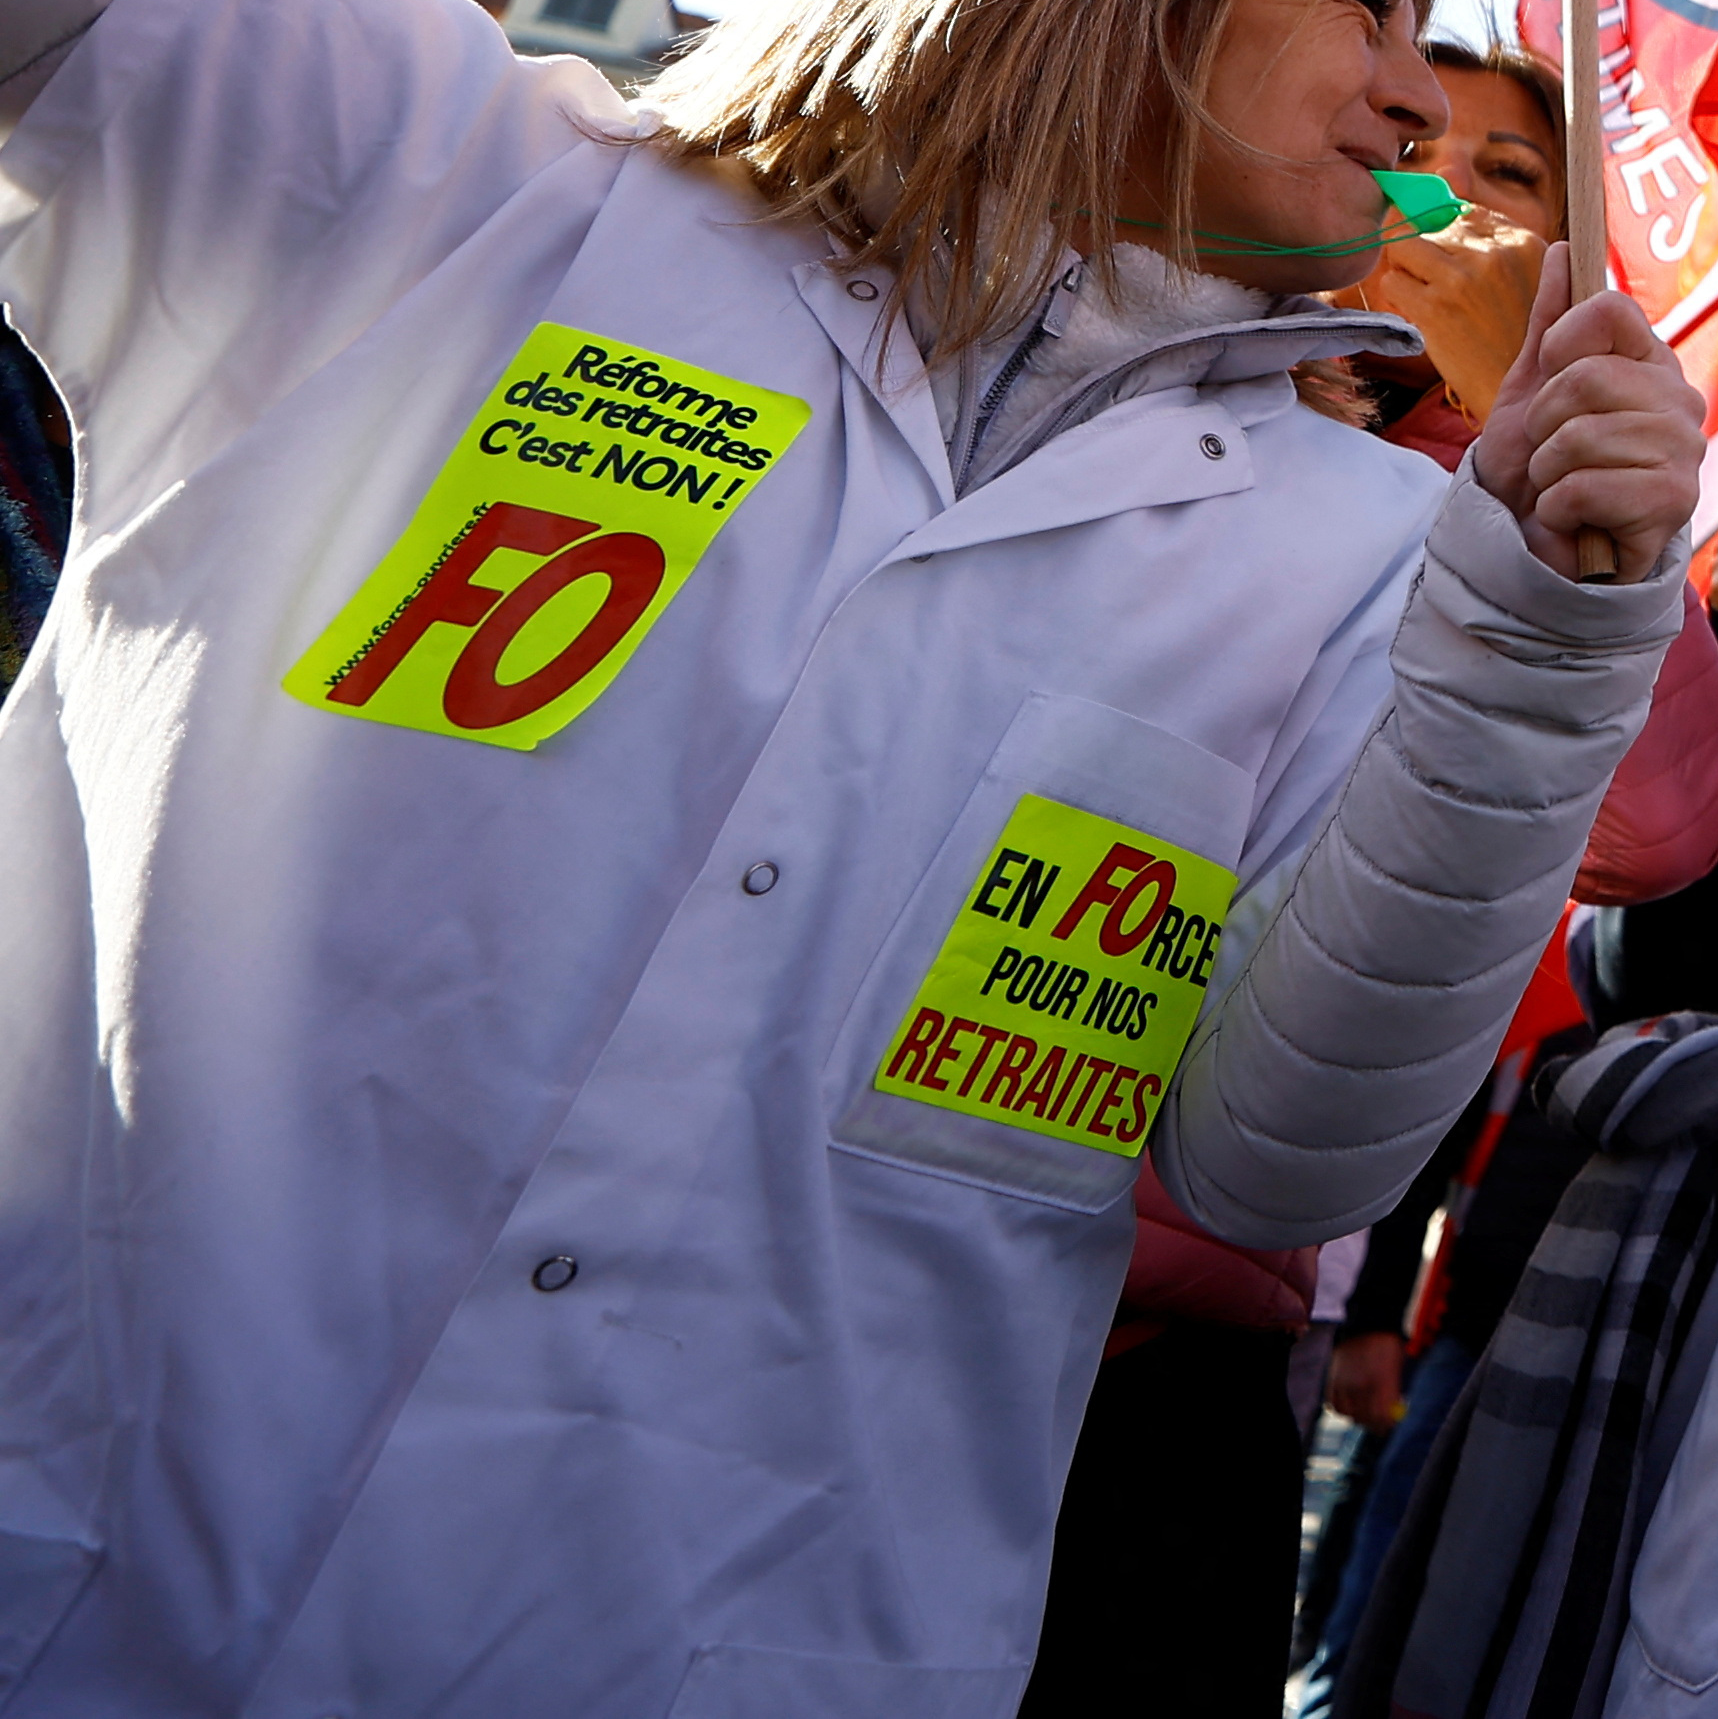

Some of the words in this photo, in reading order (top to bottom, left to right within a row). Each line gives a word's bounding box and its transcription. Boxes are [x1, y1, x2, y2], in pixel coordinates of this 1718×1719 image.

[504, 372, 584, 416] des
[580, 397, 772, 471] retraites
[562, 344, 758, 429] Réforme
[480, 419, 595, 473] C'est
[590, 443, 721, 504] NON
[712, 478, 745, 510] !
[325, 501, 666, 730] FO
[971, 848, 1062, 929] EN
[979, 945, 1090, 1021] POUR
[1081, 977, 1158, 1041] NOS
[885, 1006, 1162, 1144] RETRAITES
